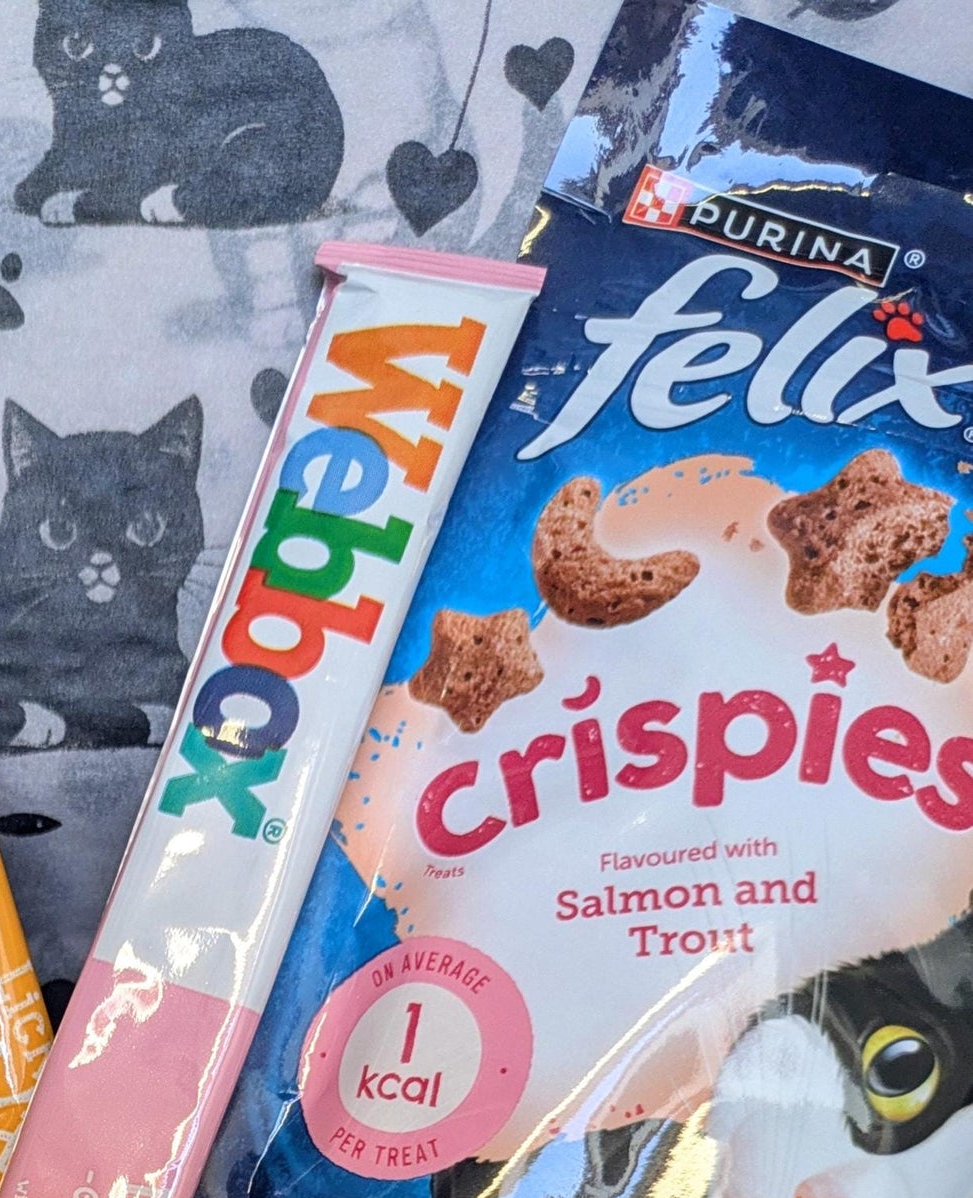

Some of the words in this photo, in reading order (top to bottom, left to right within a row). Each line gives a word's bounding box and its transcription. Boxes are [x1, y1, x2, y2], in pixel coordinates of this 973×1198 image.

[690, 203, 874, 275] PURINA
[515, 254, 973, 460] felix
[158, 316, 487, 840] Webbox
[416, 642, 973, 857] crispies
[423, 864, 465, 880] Treats
[599, 840, 717, 873] Flavoured
[724, 836, 778, 860] with
[555, 878, 723, 922] Salmon
[734, 872, 818, 905] and
[629, 922, 755, 959] Trout
[371, 960, 395, 989] ON
[402, 951, 491, 994] AVERAGE
[403, 1002, 422, 1064] 1
[356, 1067, 442, 1109] kcal
[330, 1126, 368, 1162] PER
[374, 1138, 440, 1167] TREAT
